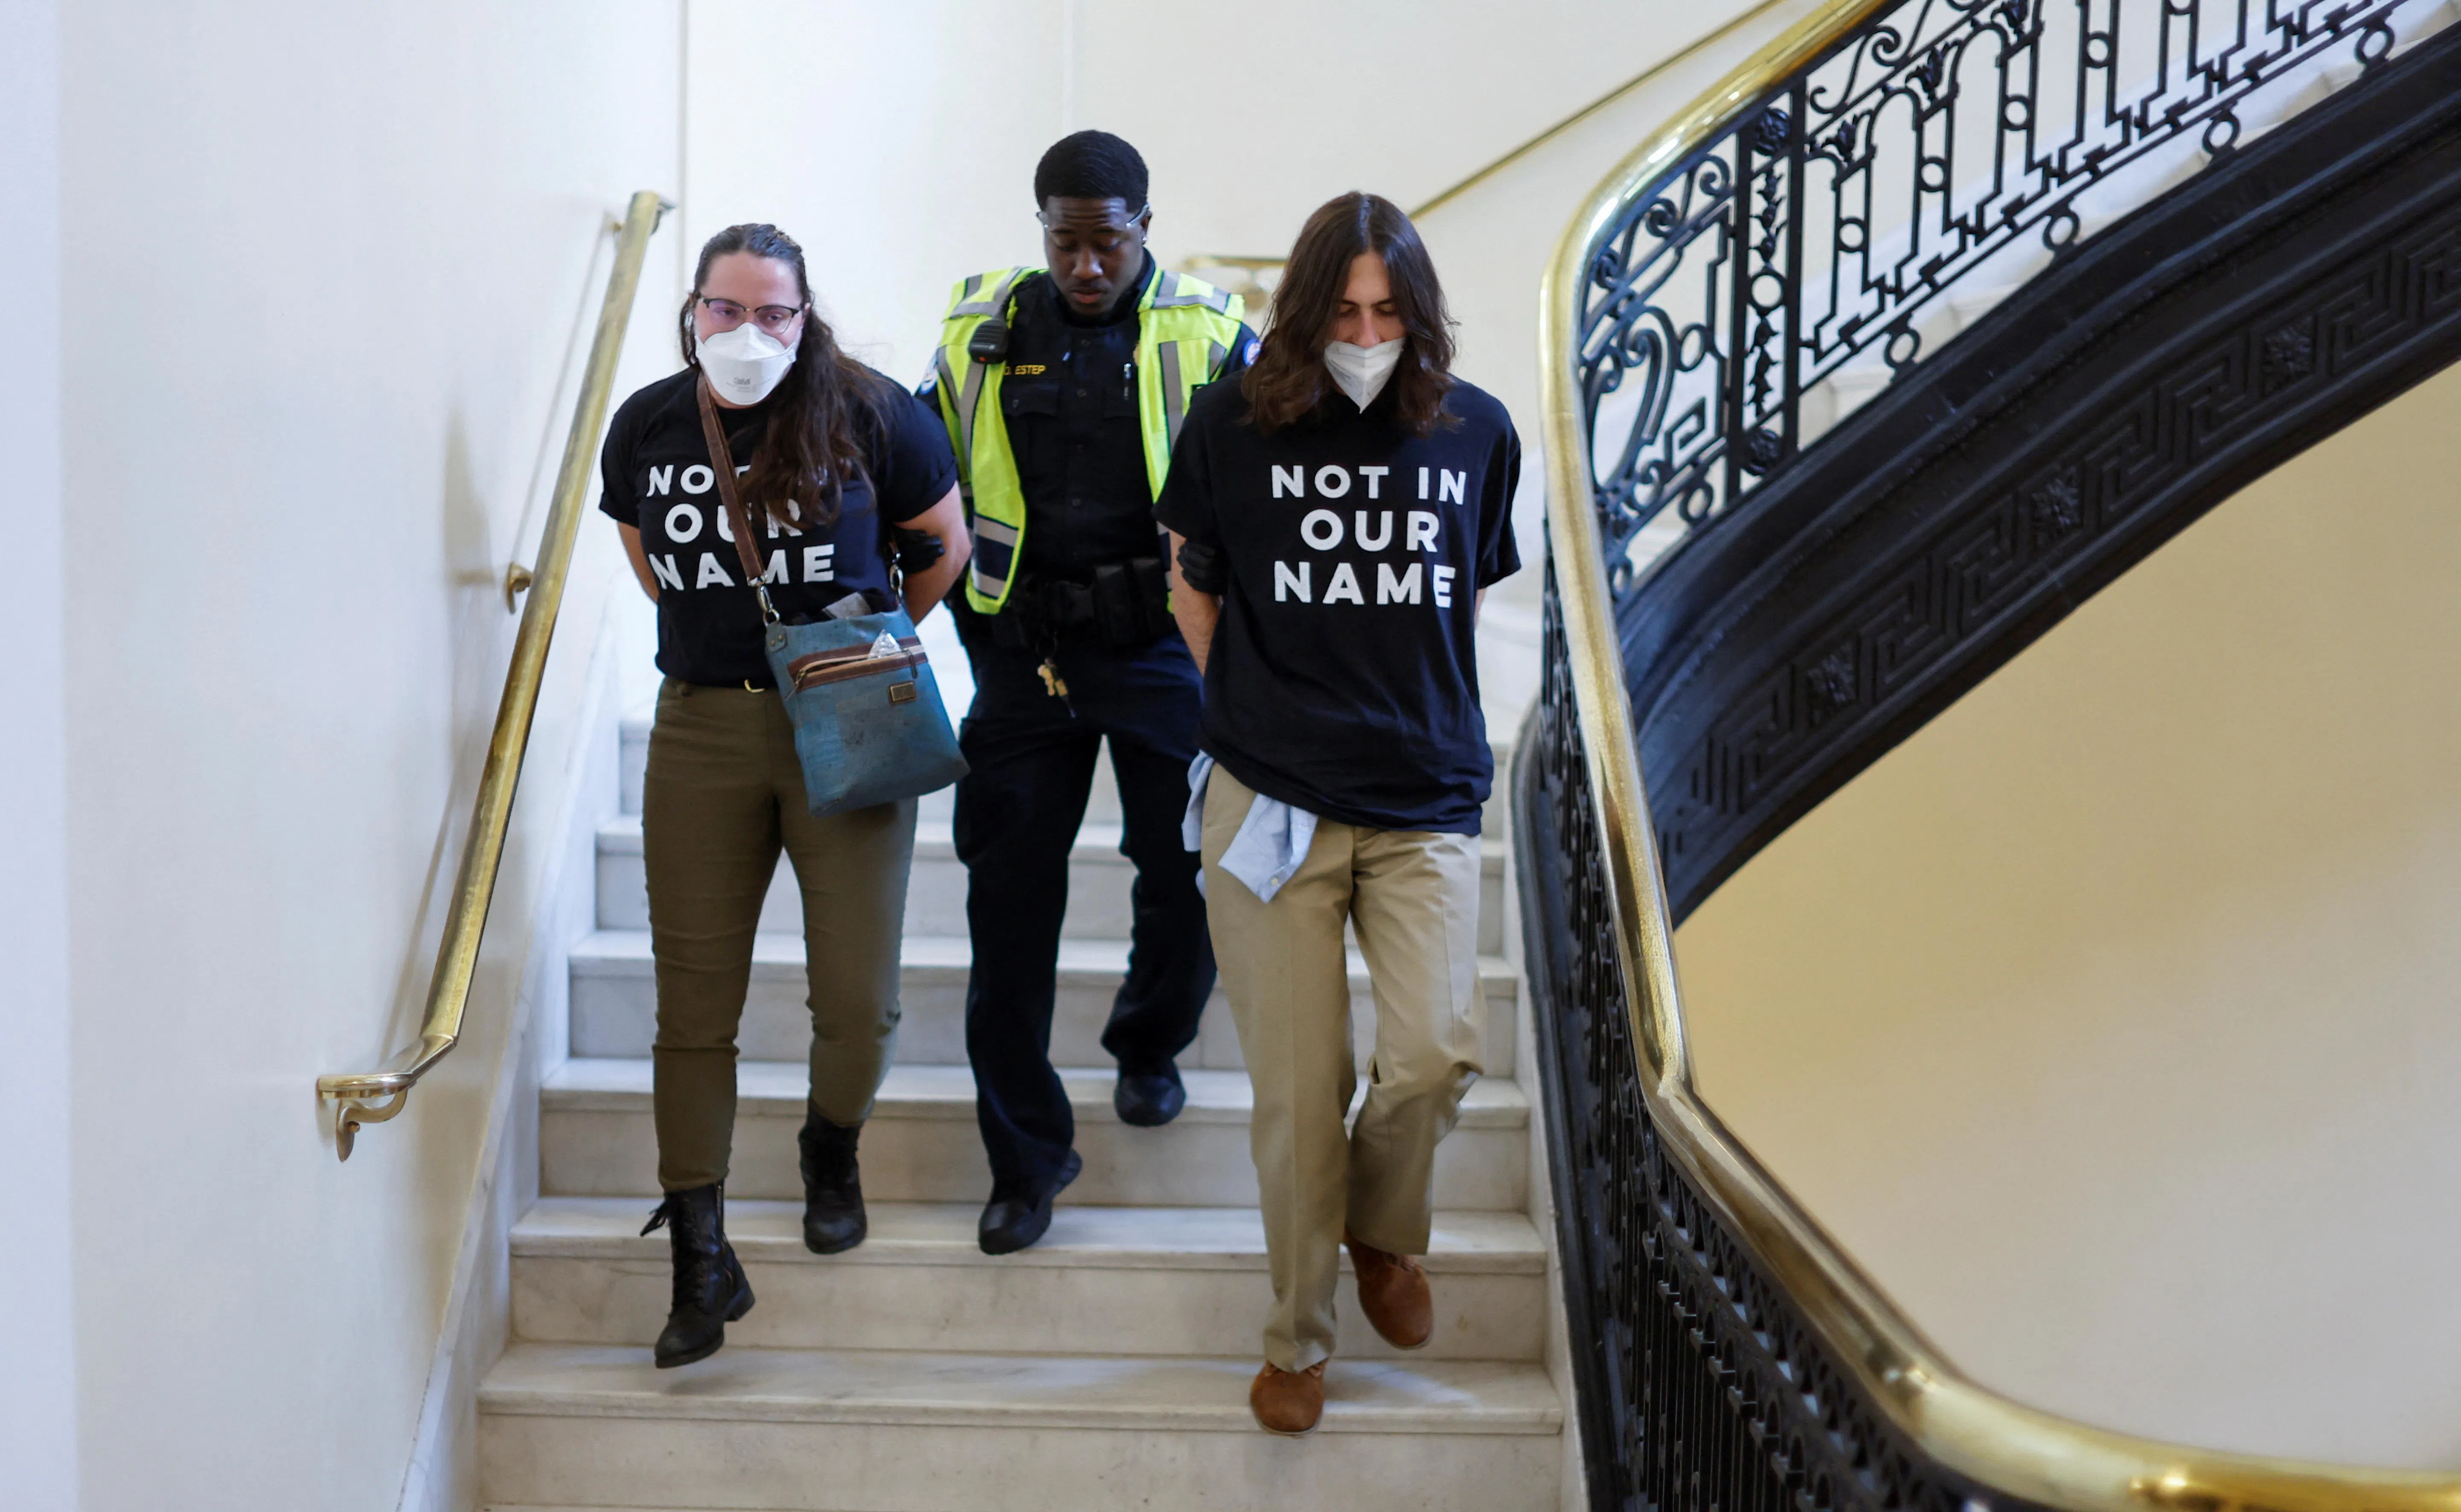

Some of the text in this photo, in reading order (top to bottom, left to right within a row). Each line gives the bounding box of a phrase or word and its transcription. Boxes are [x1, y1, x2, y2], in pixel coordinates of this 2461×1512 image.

[1015, 365, 1046, 375] ESTEP
[646, 464, 751, 497] NO
[1271, 464, 1467, 505] NOT IN
[1300, 509, 1440, 552] OUR
[648, 544, 835, 591] NAME
[1274, 561, 1456, 608] NAME
